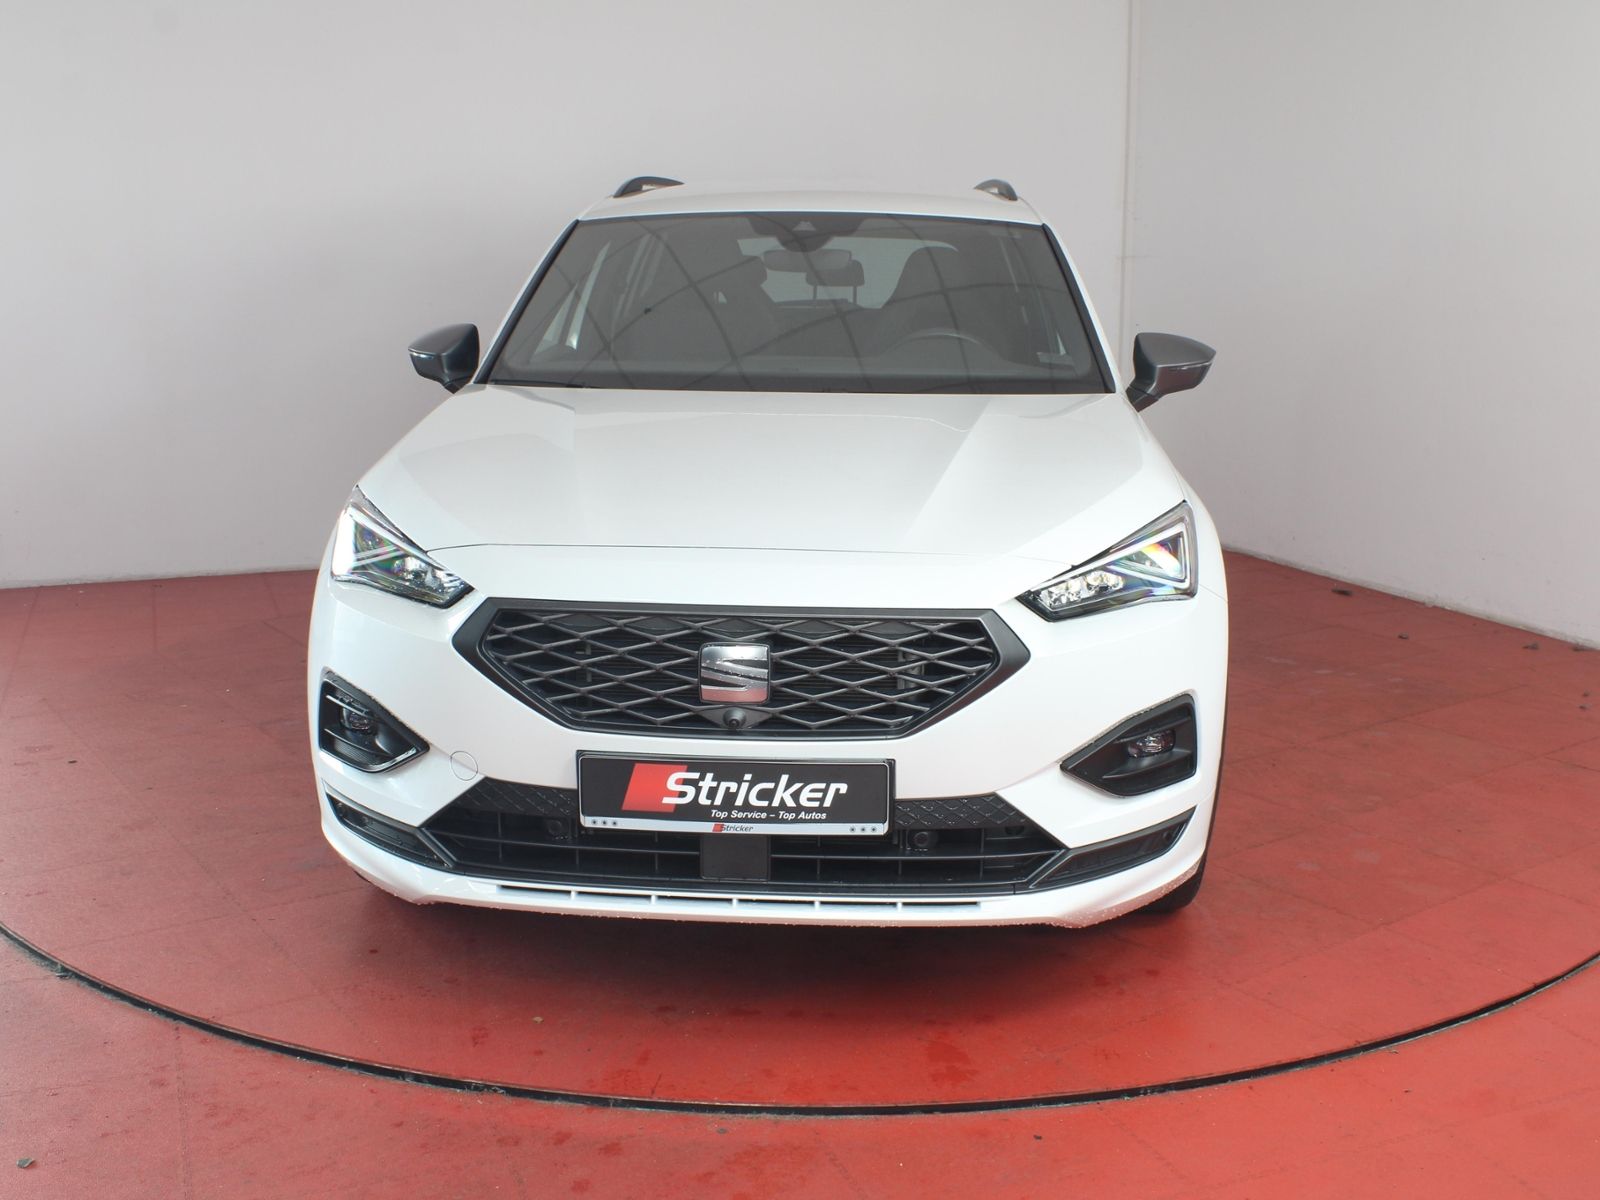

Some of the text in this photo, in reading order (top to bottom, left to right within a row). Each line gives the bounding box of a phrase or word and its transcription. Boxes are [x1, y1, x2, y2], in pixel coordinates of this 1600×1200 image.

[662, 772, 848, 807] Stricker
[711, 809, 728, 820] Top
[731, 810, 767, 820] Service
[778, 811, 796, 821] Top
[798, 811, 827, 820] Autos
[720, 824, 754, 832] Stricker
